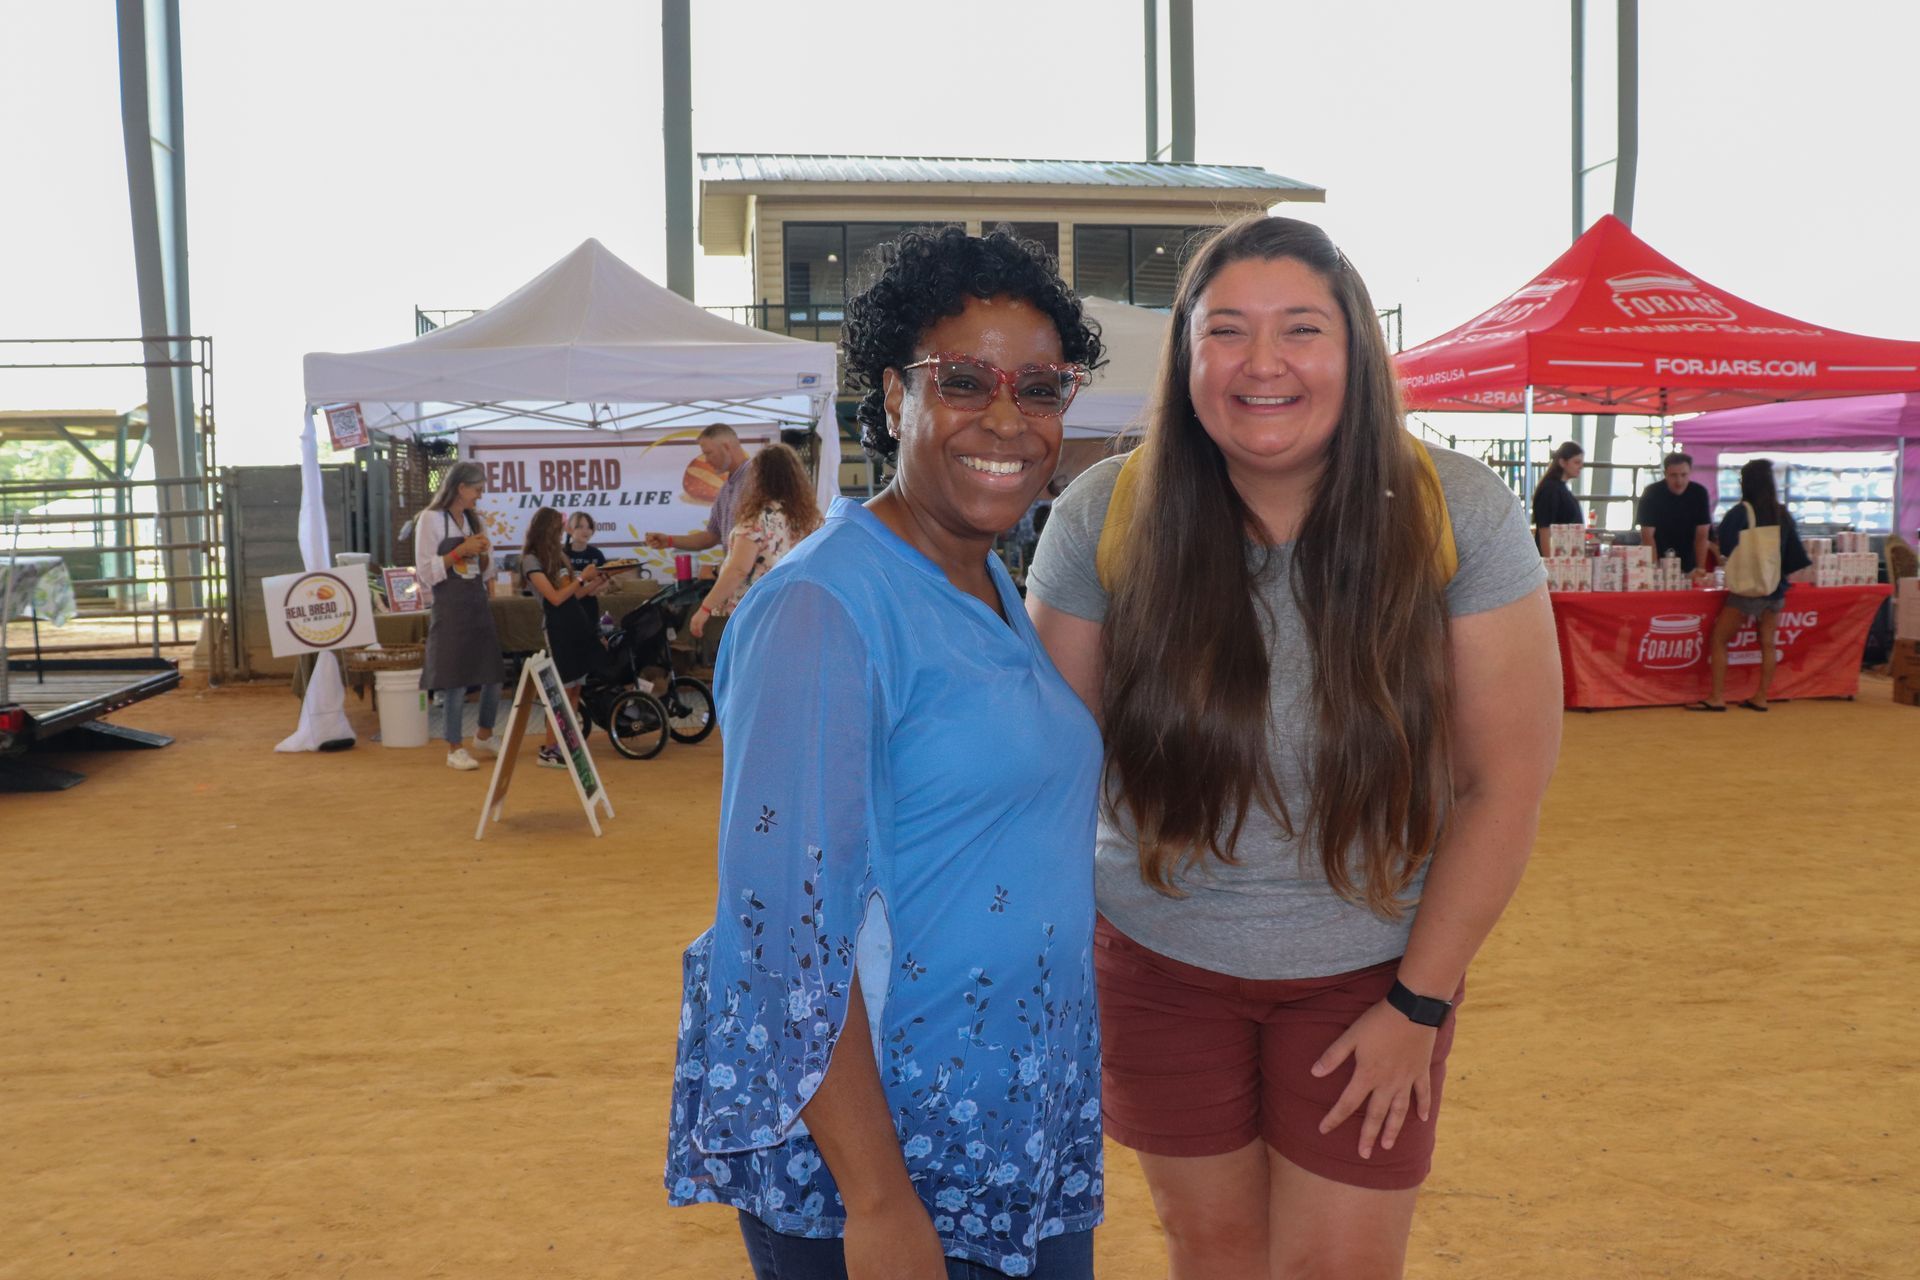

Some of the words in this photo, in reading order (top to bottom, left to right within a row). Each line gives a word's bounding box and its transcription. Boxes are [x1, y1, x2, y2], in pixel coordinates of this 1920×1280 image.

[1613, 294, 1724, 318] FORJARS
[1578, 323, 1716, 334] CANNING
[1717, 323, 1826, 337] SUPPLY
[1655, 358, 1817, 376] FORJARS.COM
[474, 461, 532, 493] EAL
[539, 458, 621, 492] BREAD
[518, 494, 544, 508] IN
[552, 492, 612, 507] REAL
[619, 490, 672, 506] LIFE
[286, 605, 306, 619] REAL
[309, 602, 336, 616] BREAD
[1638, 632, 1703, 662] FORJARS
